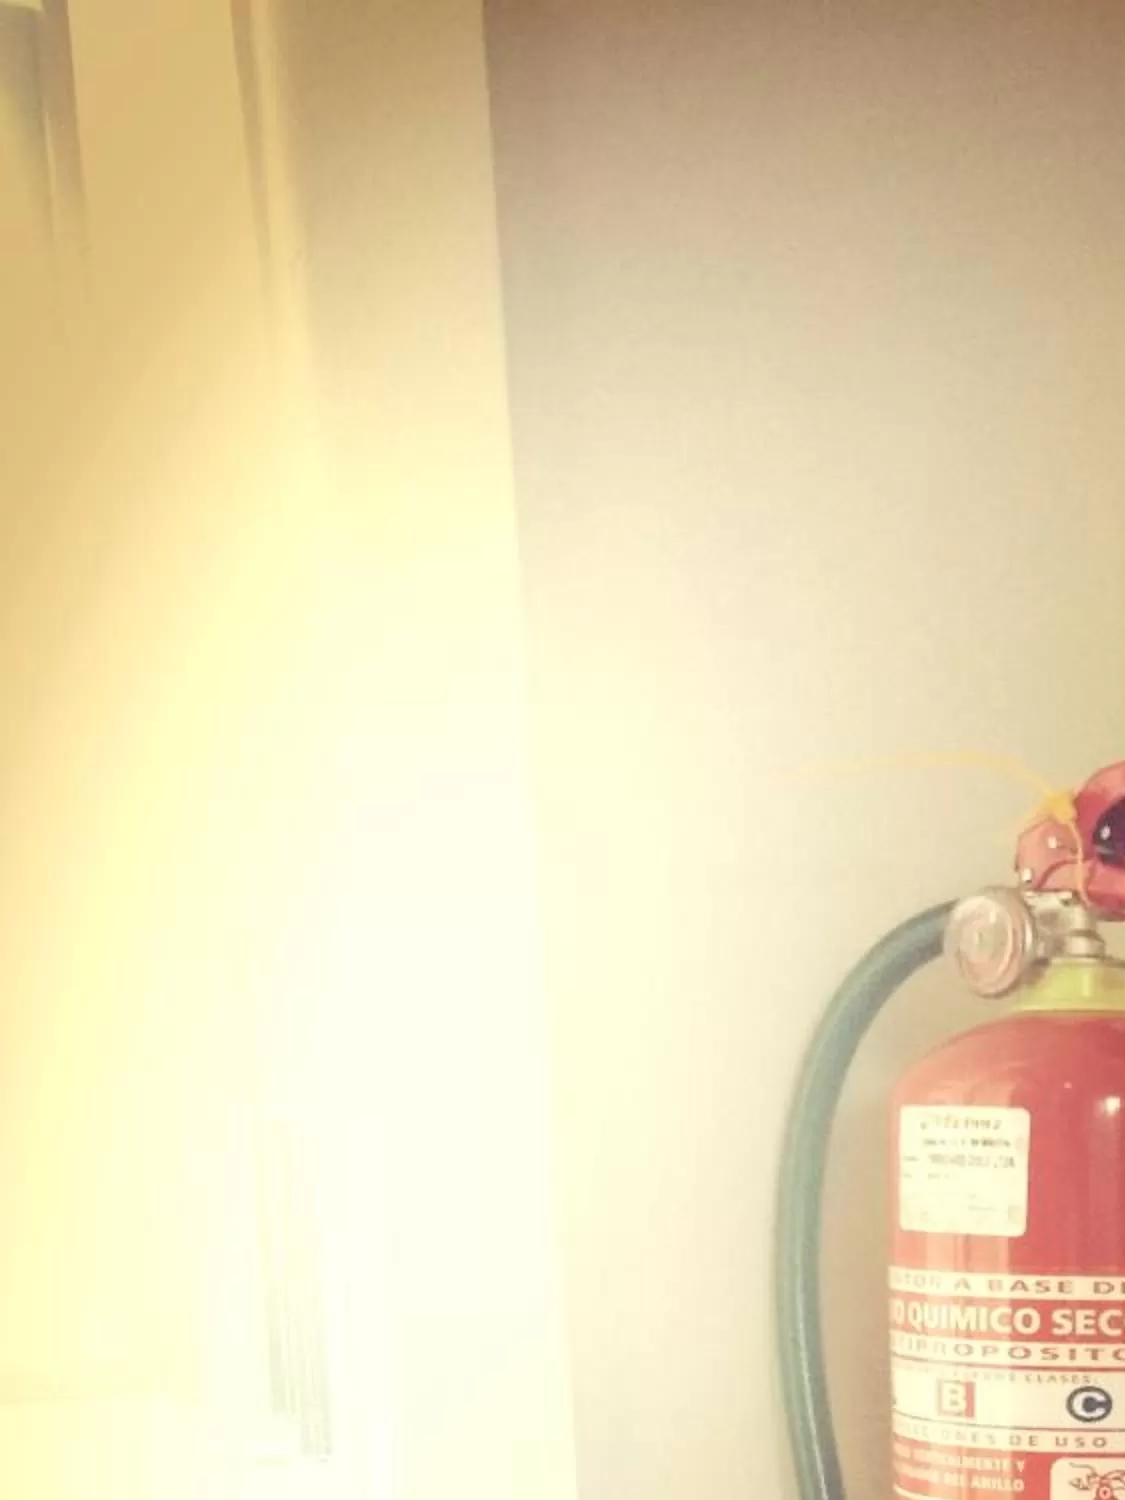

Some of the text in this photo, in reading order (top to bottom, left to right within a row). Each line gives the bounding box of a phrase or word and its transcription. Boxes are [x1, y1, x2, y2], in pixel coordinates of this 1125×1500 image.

[953, 1277, 972, 1291] A
[987, 1279, 1075, 1295] BASE
[908, 1302, 1041, 1335] QUIMICO
[1009, 1434, 1040, 1447] DE
[1055, 1435, 1108, 1448] USO
